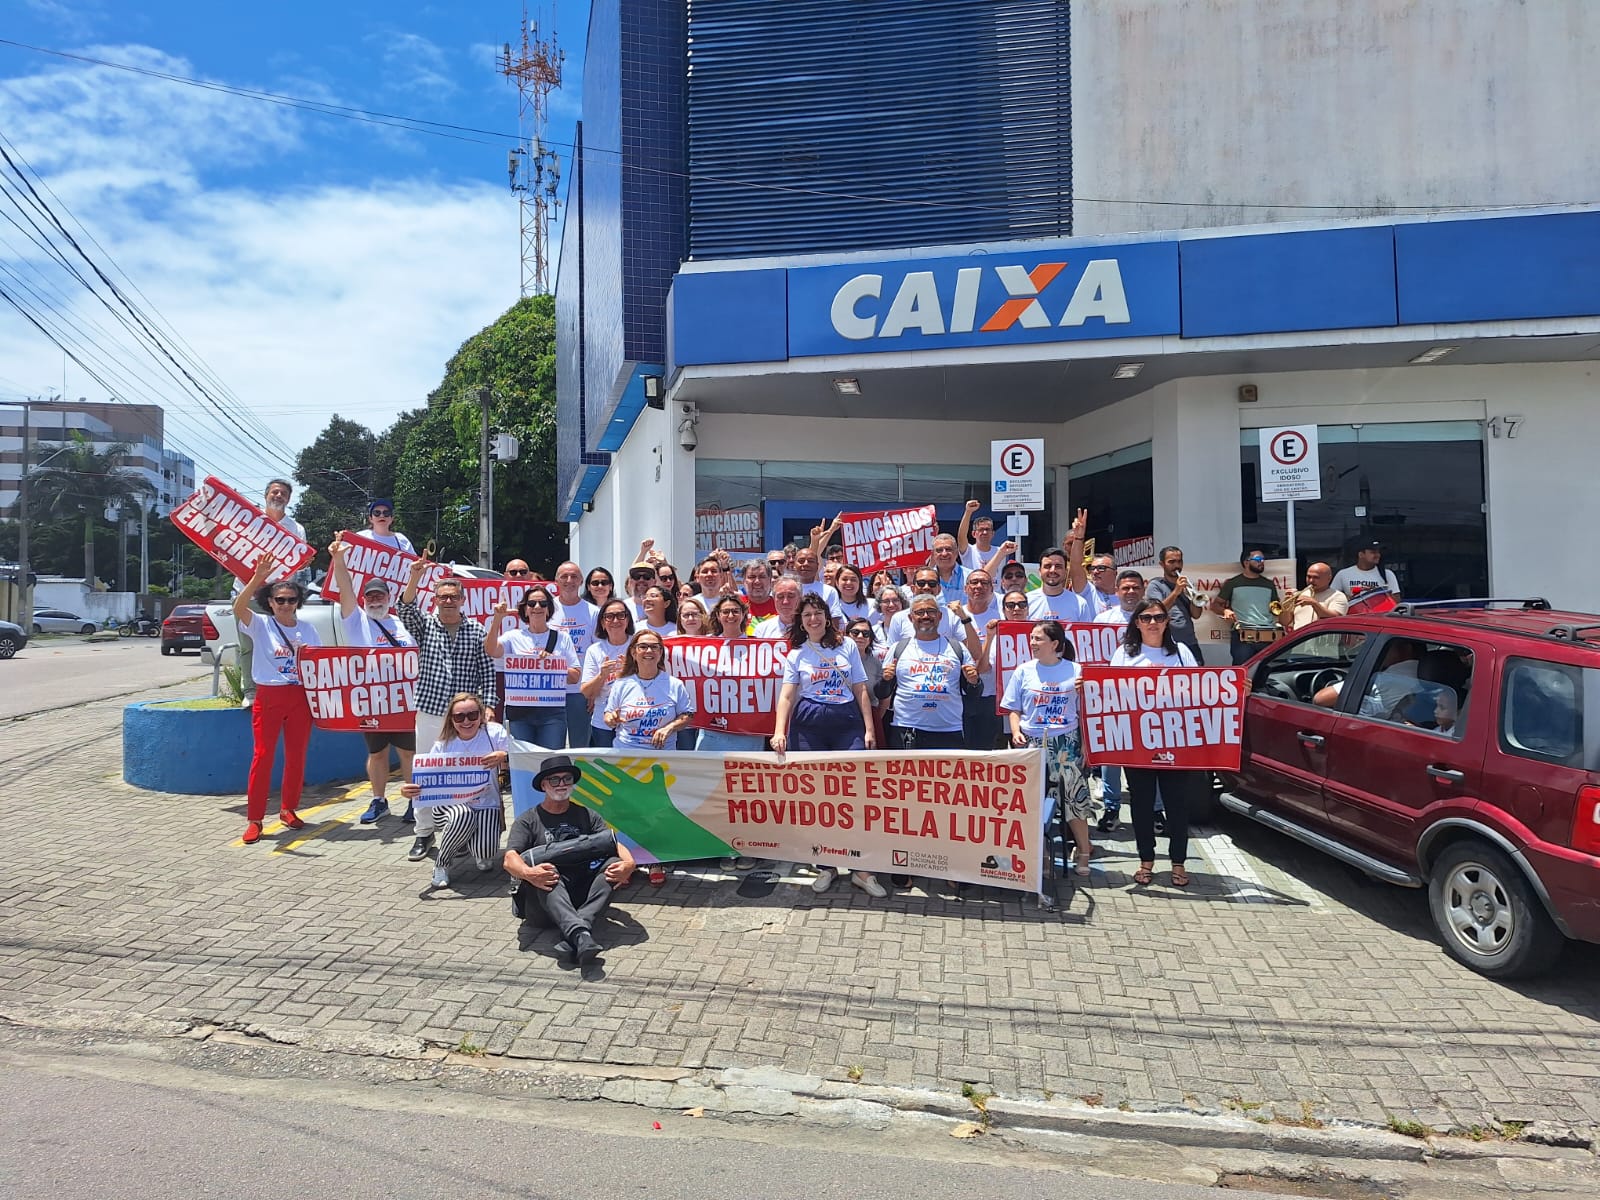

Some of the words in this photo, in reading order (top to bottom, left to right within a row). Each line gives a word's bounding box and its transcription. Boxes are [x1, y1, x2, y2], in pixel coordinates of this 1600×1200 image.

[830, 259, 1131, 340] CAIXA
[1011, 452, 1023, 470] E
[1282, 438, 1296, 458] E
[1271, 467, 1310, 475] EXCLUSIVO
[176, 504, 218, 538] EM
[190, 485, 308, 567] BANCÁRIOS
[843, 508, 932, 546] BANCÁRIOS
[716, 530, 760, 550] GREVE
[845, 545, 875, 569] EM
[877, 527, 935, 562] GREVE
[301, 648, 420, 690] BANCÁRIO
[505, 673, 528, 688] VIDAS
[529, 674, 541, 689] EM
[506, 656, 543, 670] SAÚDE
[305, 689, 345, 719] EM
[350, 681, 419, 718] GREV
[1083, 669, 1238, 714] BANCÁRIOS
[1086, 713, 1134, 753] EM
[1140, 706, 1240, 750] GREVE
[414, 757, 444, 767] PLANO
[445, 756, 457, 767] DE
[414, 774, 437, 787] JUSTO
[438, 774, 444, 785] E
[444, 772, 489, 785] IGUALITÁRIO
[725, 772, 816, 795] FEITOS
[823, 775, 857, 797] DE
[865, 776, 1028, 816] ESPERANÇA
[727, 799, 854, 830] MOVIDOS
[863, 804, 939, 839] PELA
[949, 812, 1026, 851] LUTA
[910, 851, 949, 861] COMANDO
